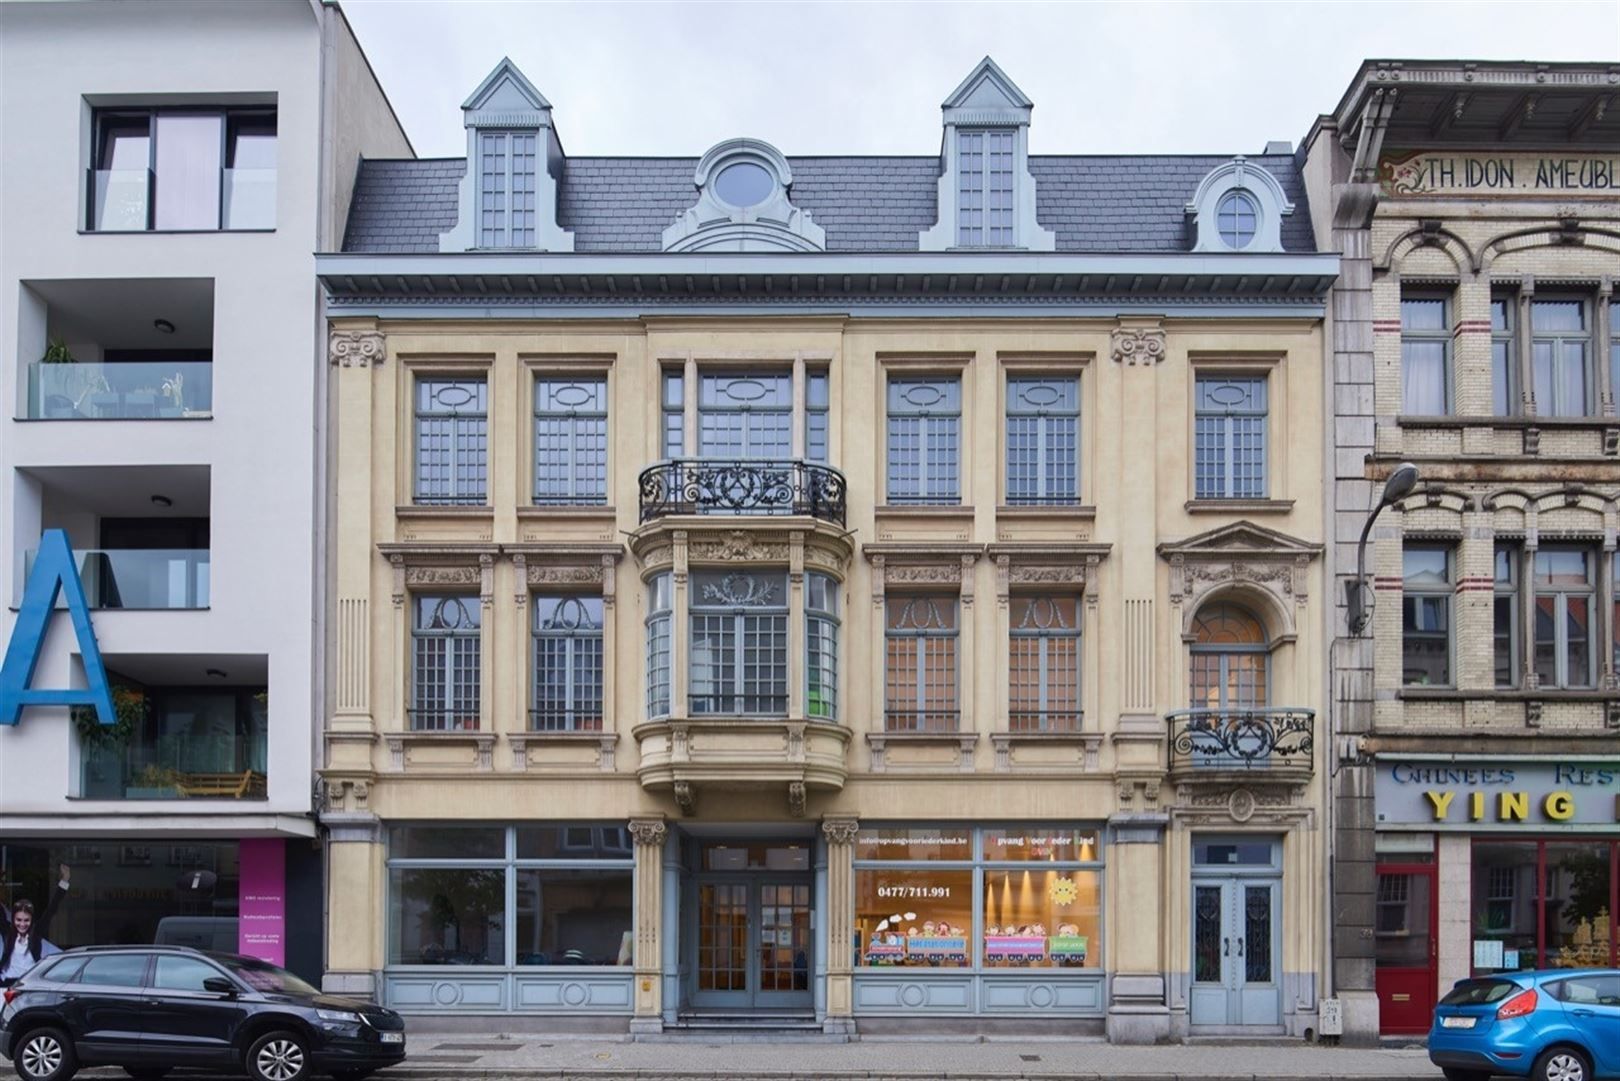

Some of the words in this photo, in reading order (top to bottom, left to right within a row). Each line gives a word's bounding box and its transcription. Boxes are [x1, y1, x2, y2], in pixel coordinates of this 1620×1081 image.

[1555, 762, 1620, 786] RES
[1425, 790, 1576, 820] YING
[877, 886, 951, 898] 0477/711.991
